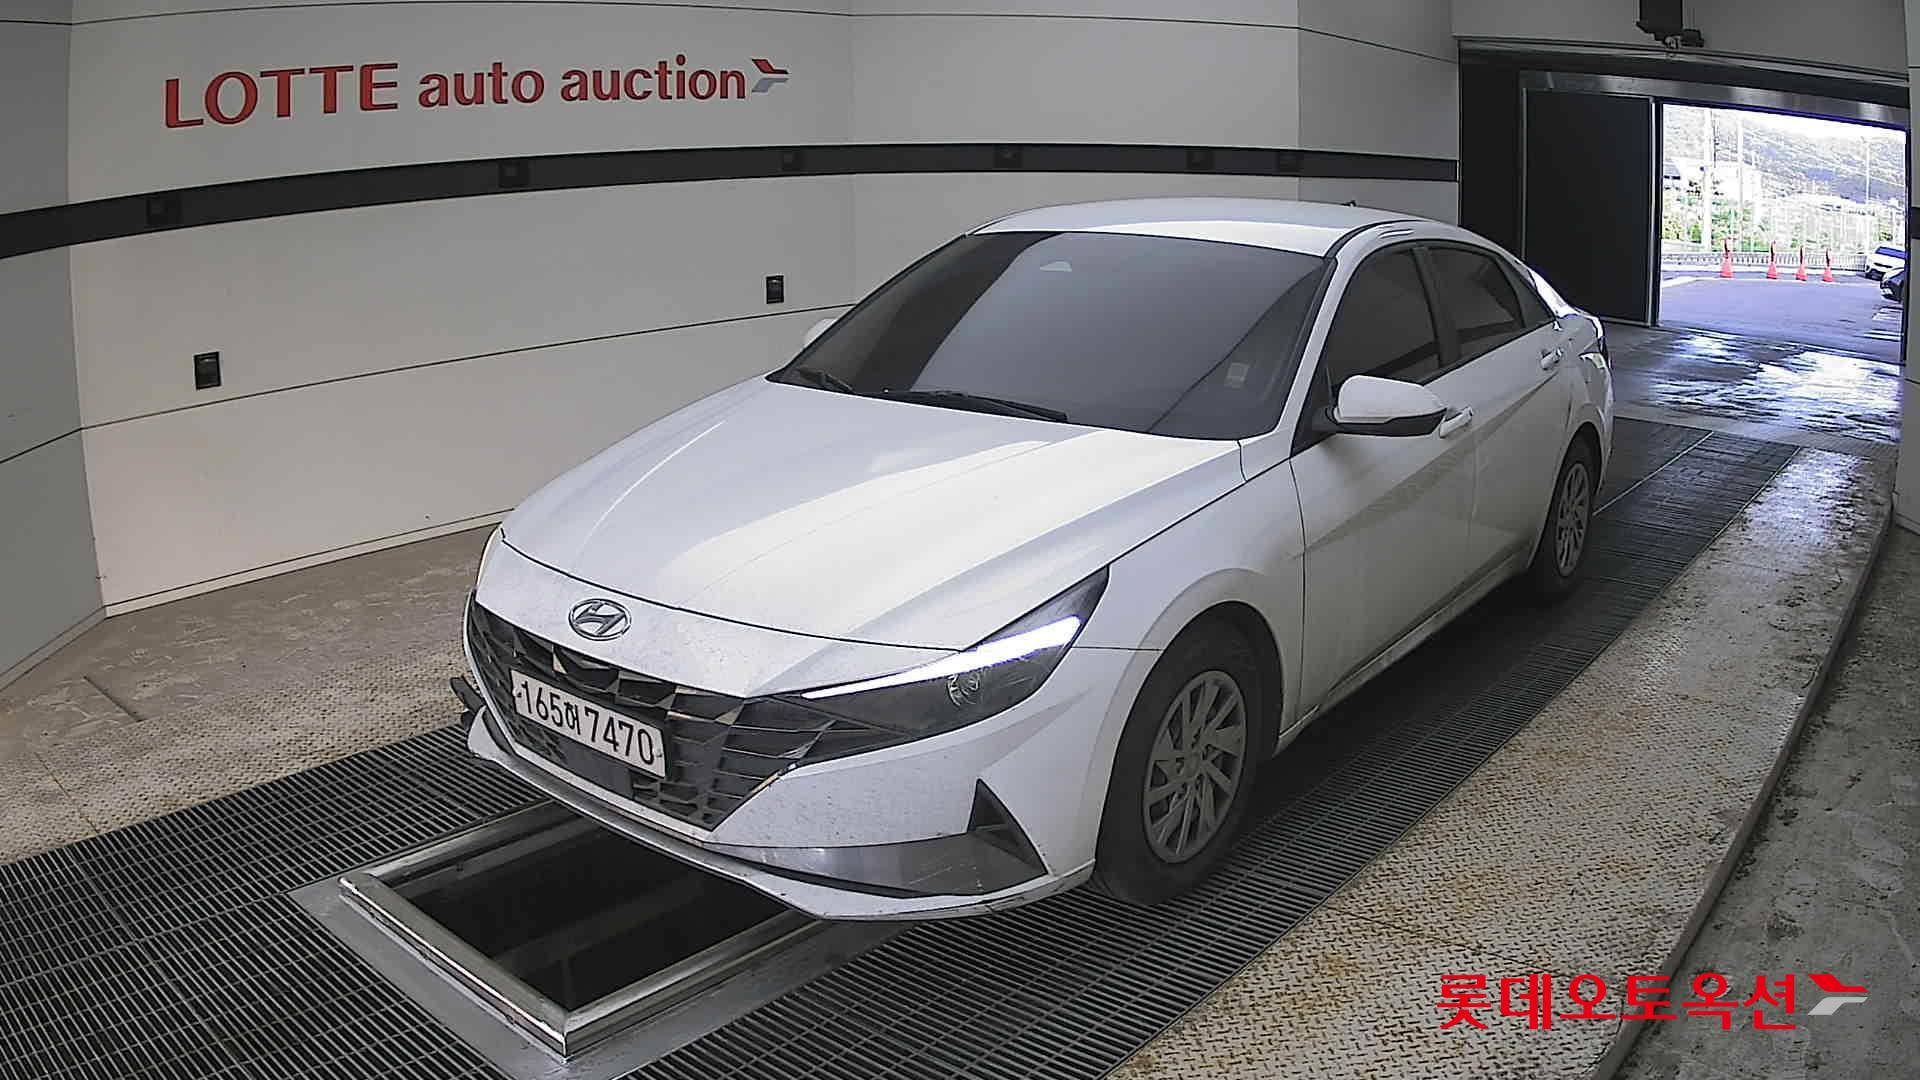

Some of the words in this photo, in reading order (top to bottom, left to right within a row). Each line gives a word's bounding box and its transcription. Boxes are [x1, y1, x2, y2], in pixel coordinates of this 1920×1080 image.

[164, 63, 398, 128] LOTTE
[418, 62, 545, 107] auto
[561, 54, 747, 102] auction
